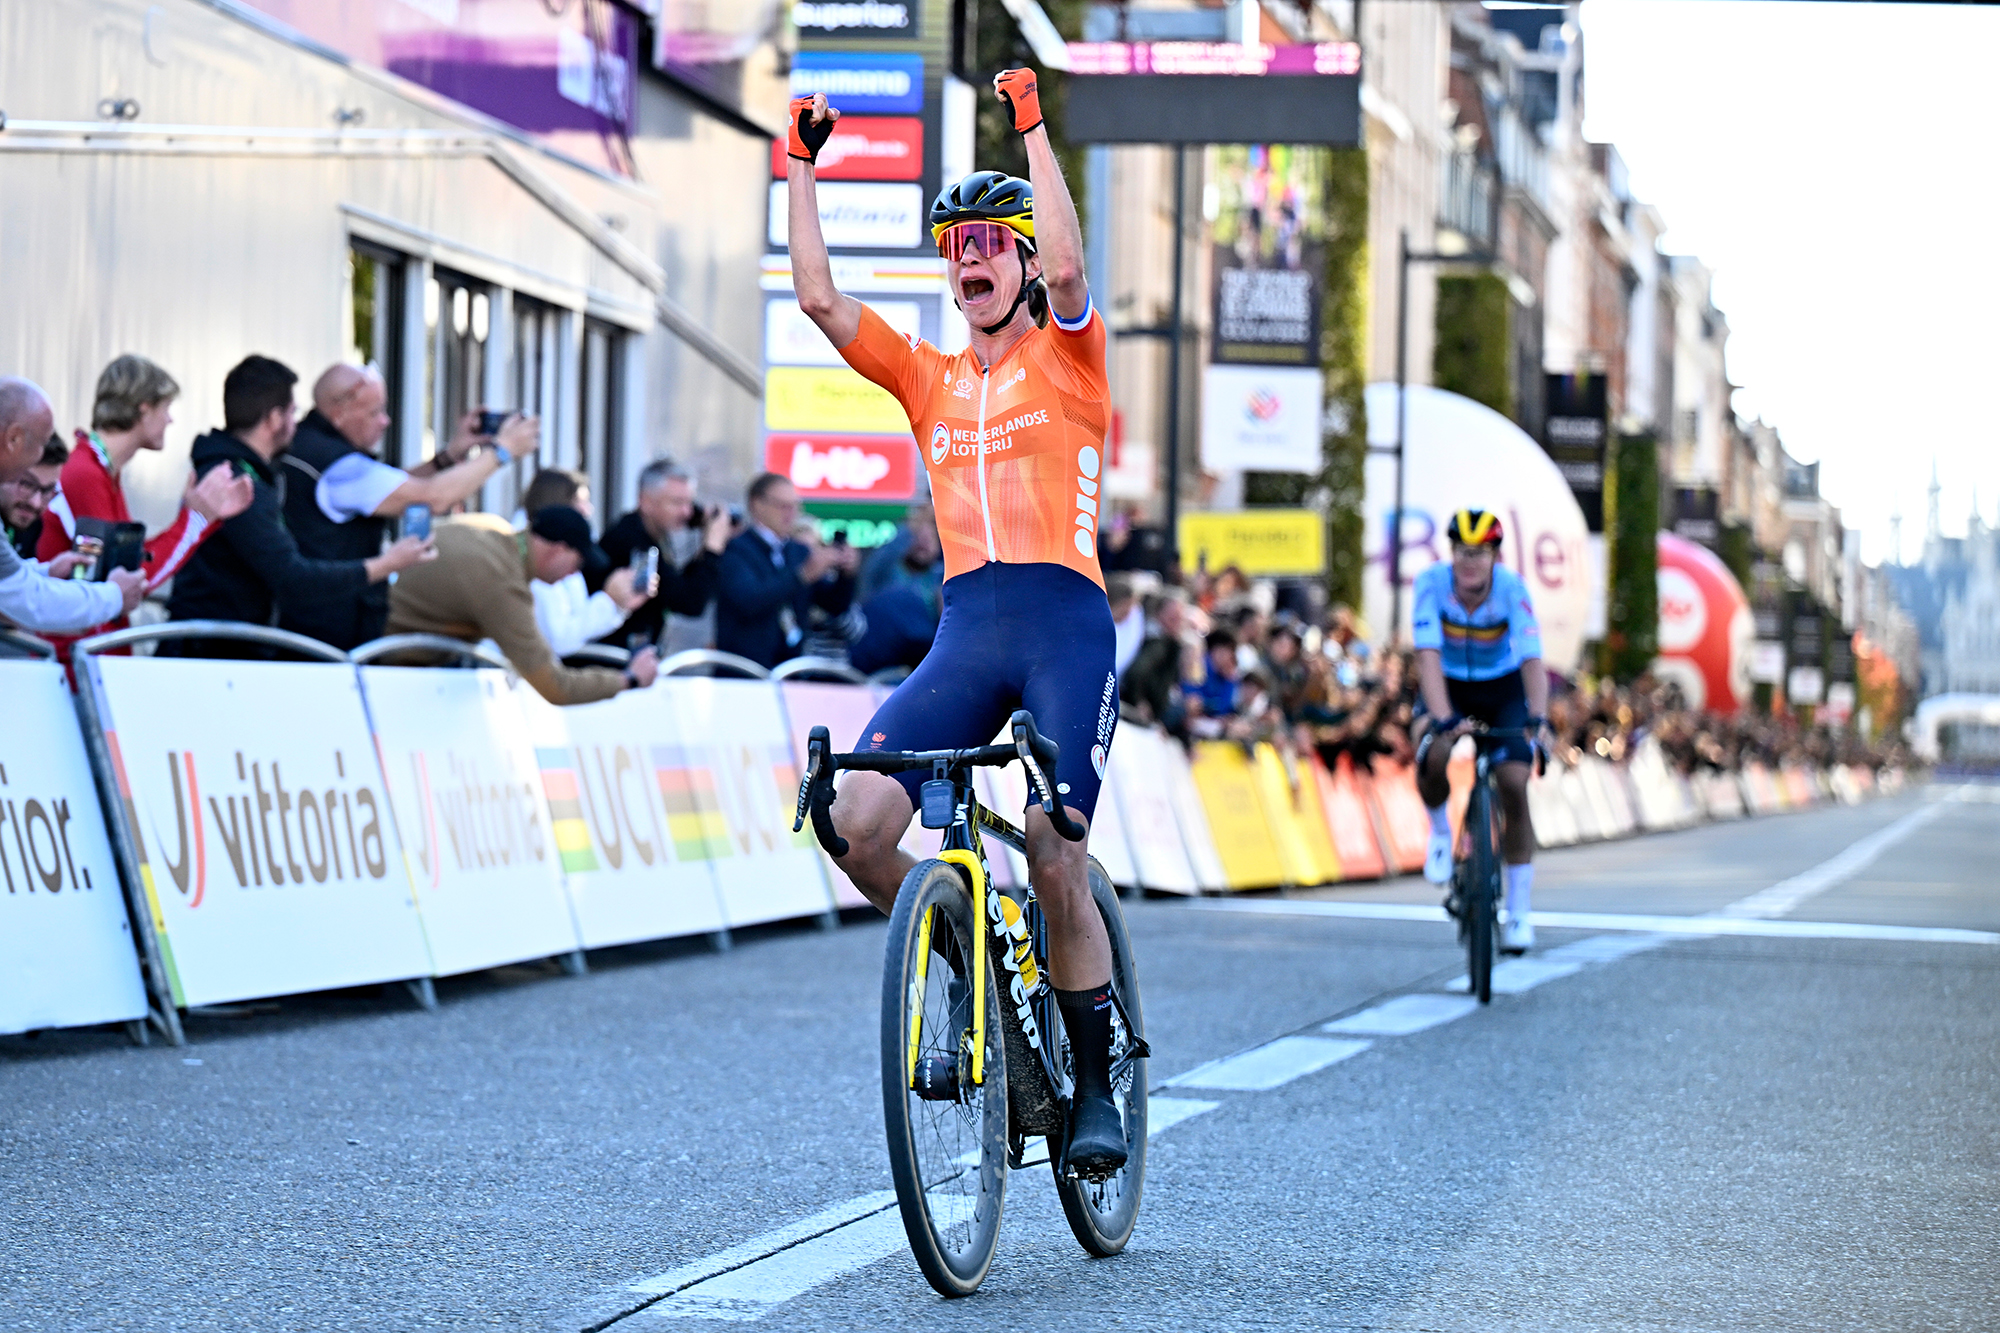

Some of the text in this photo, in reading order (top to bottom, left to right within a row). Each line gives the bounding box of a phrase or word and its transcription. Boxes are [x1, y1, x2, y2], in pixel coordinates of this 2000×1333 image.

[952, 409, 1050, 443] NEDERLANDSE
[209, 750, 387, 888] vittoria
[575, 743, 670, 870] UCI
